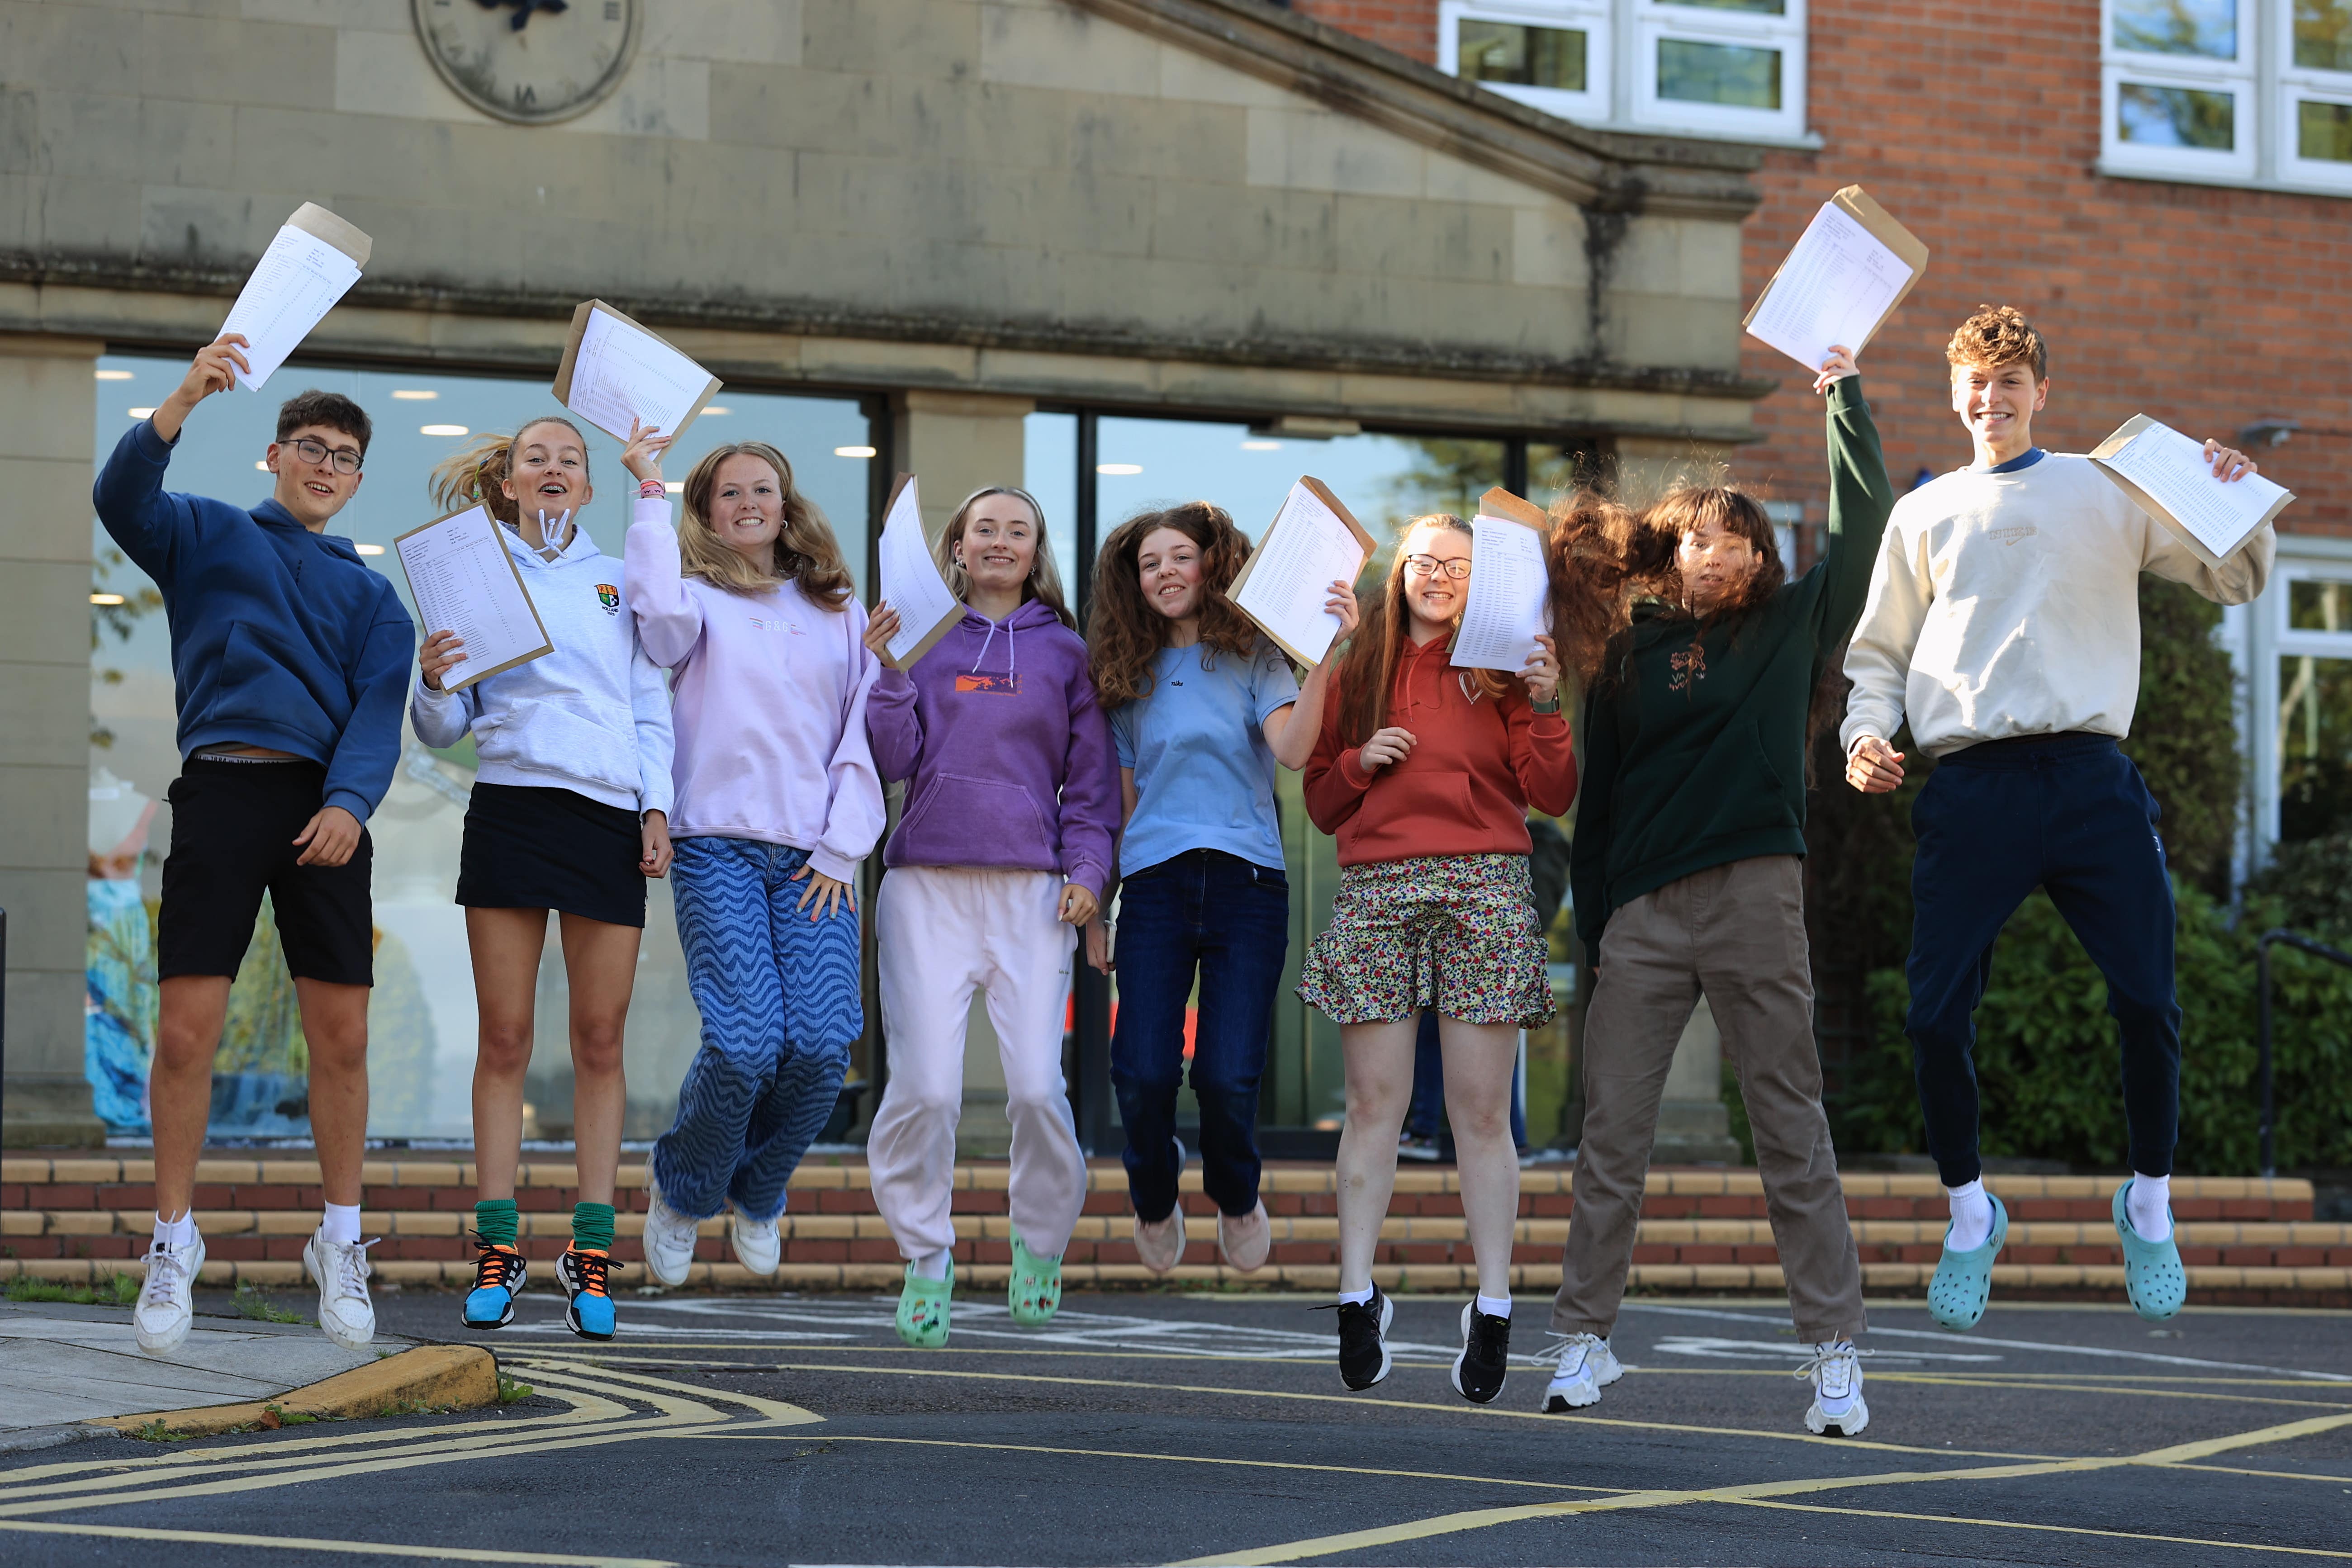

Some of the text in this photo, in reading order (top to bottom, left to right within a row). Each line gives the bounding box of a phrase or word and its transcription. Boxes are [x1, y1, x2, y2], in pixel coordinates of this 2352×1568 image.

[1989, 526, 2037, 540] NIKE
[765, 620, 788, 632] G & G
